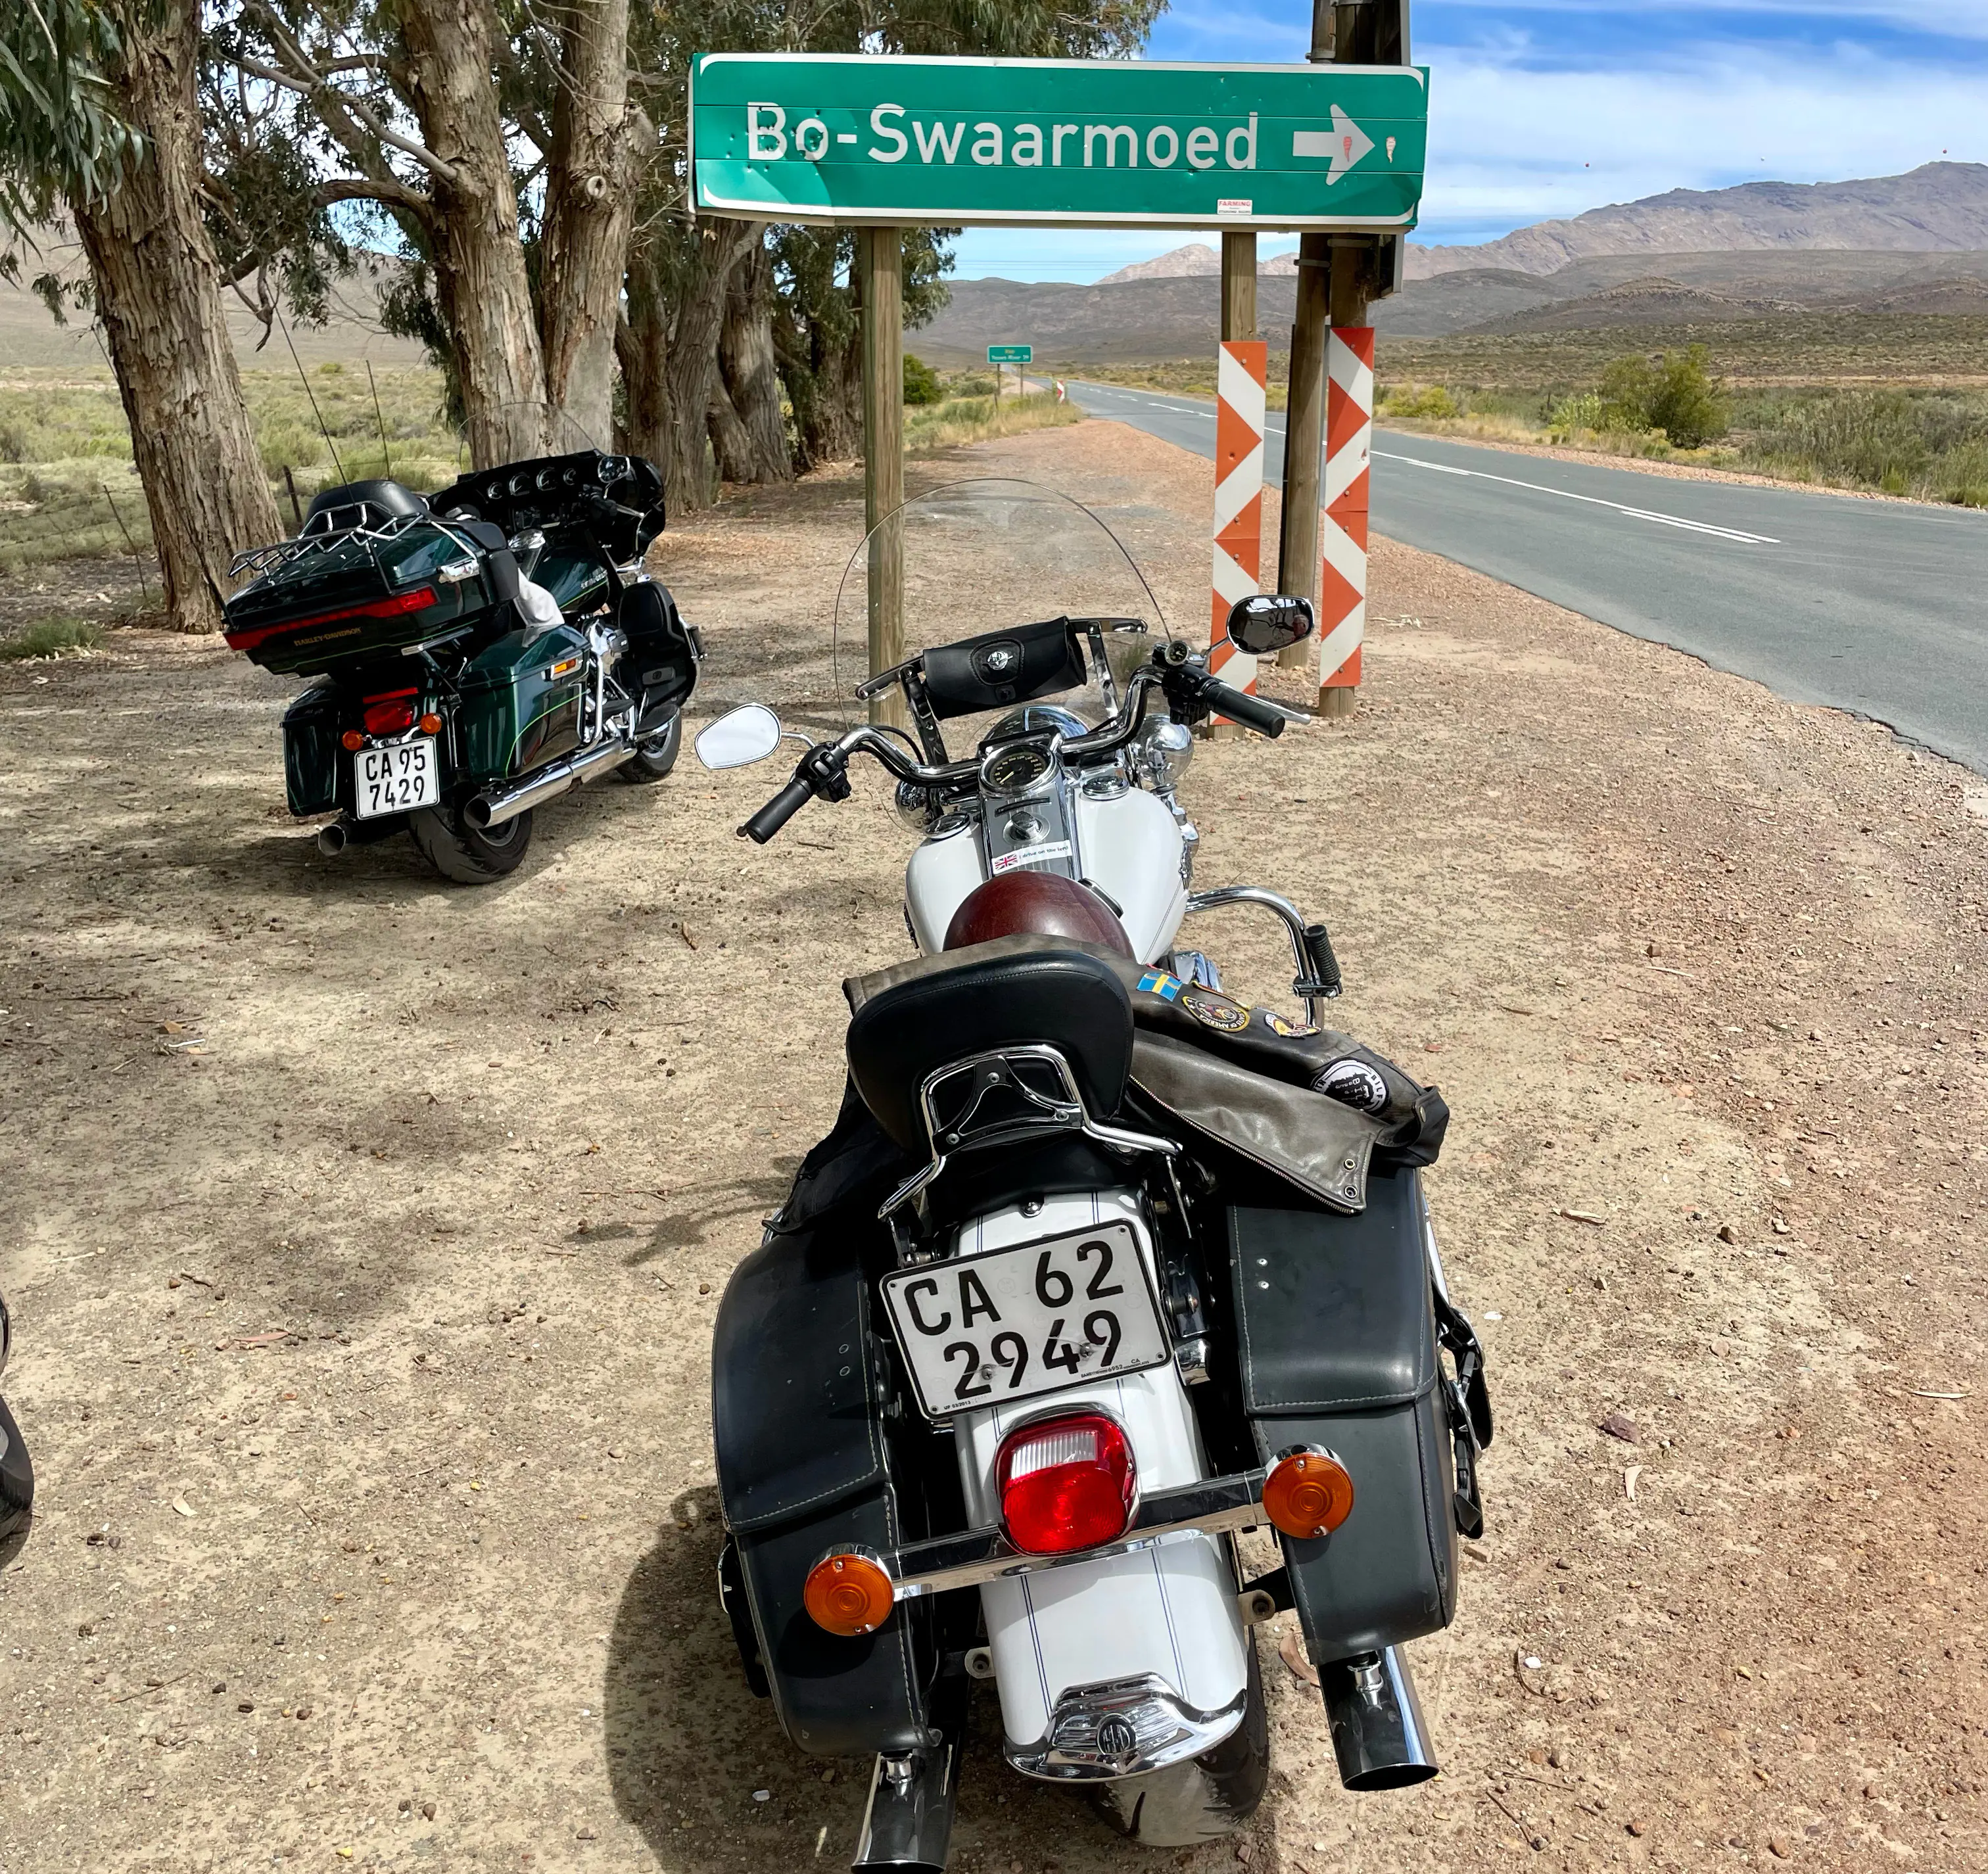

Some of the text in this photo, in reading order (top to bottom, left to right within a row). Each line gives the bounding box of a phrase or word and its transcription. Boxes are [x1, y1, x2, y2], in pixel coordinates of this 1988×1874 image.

[747, 101, 1258, 170] Bo-Swaarmoed
[366, 745, 426, 781] CA 95
[369, 776, 425, 810] 7429
[1200, 1014, 1229, 1029] AMERICA
[903, 1240, 1124, 1336] CA 62
[943, 1309, 1122, 1401] 2949
